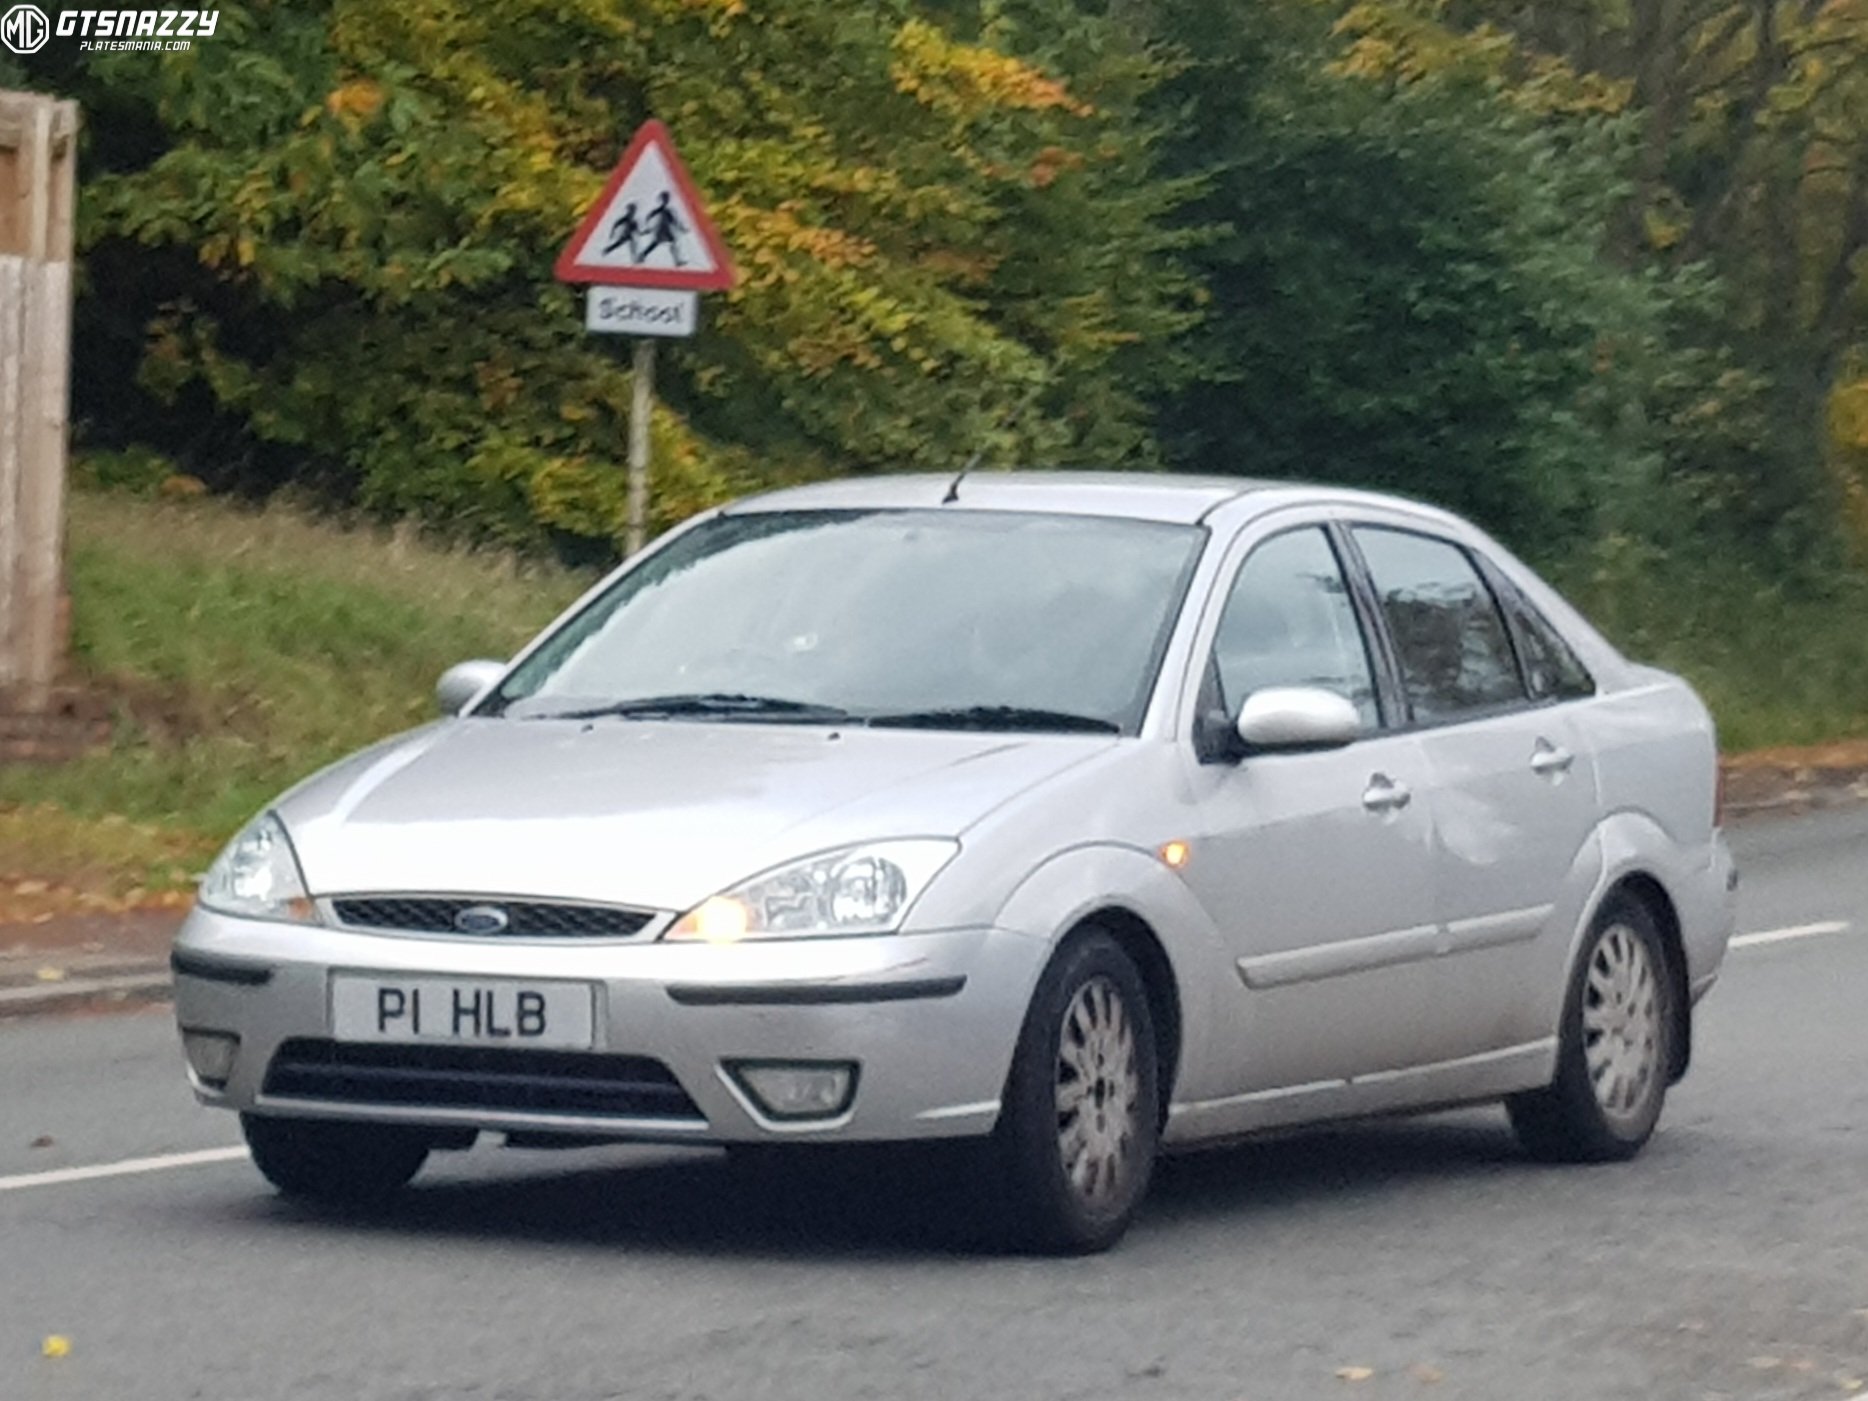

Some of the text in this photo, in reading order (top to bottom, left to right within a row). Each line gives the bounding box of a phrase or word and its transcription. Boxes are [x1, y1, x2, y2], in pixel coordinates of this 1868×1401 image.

[598, 297, 685, 325] School
[377, 987, 547, 1038] P1 HLB
